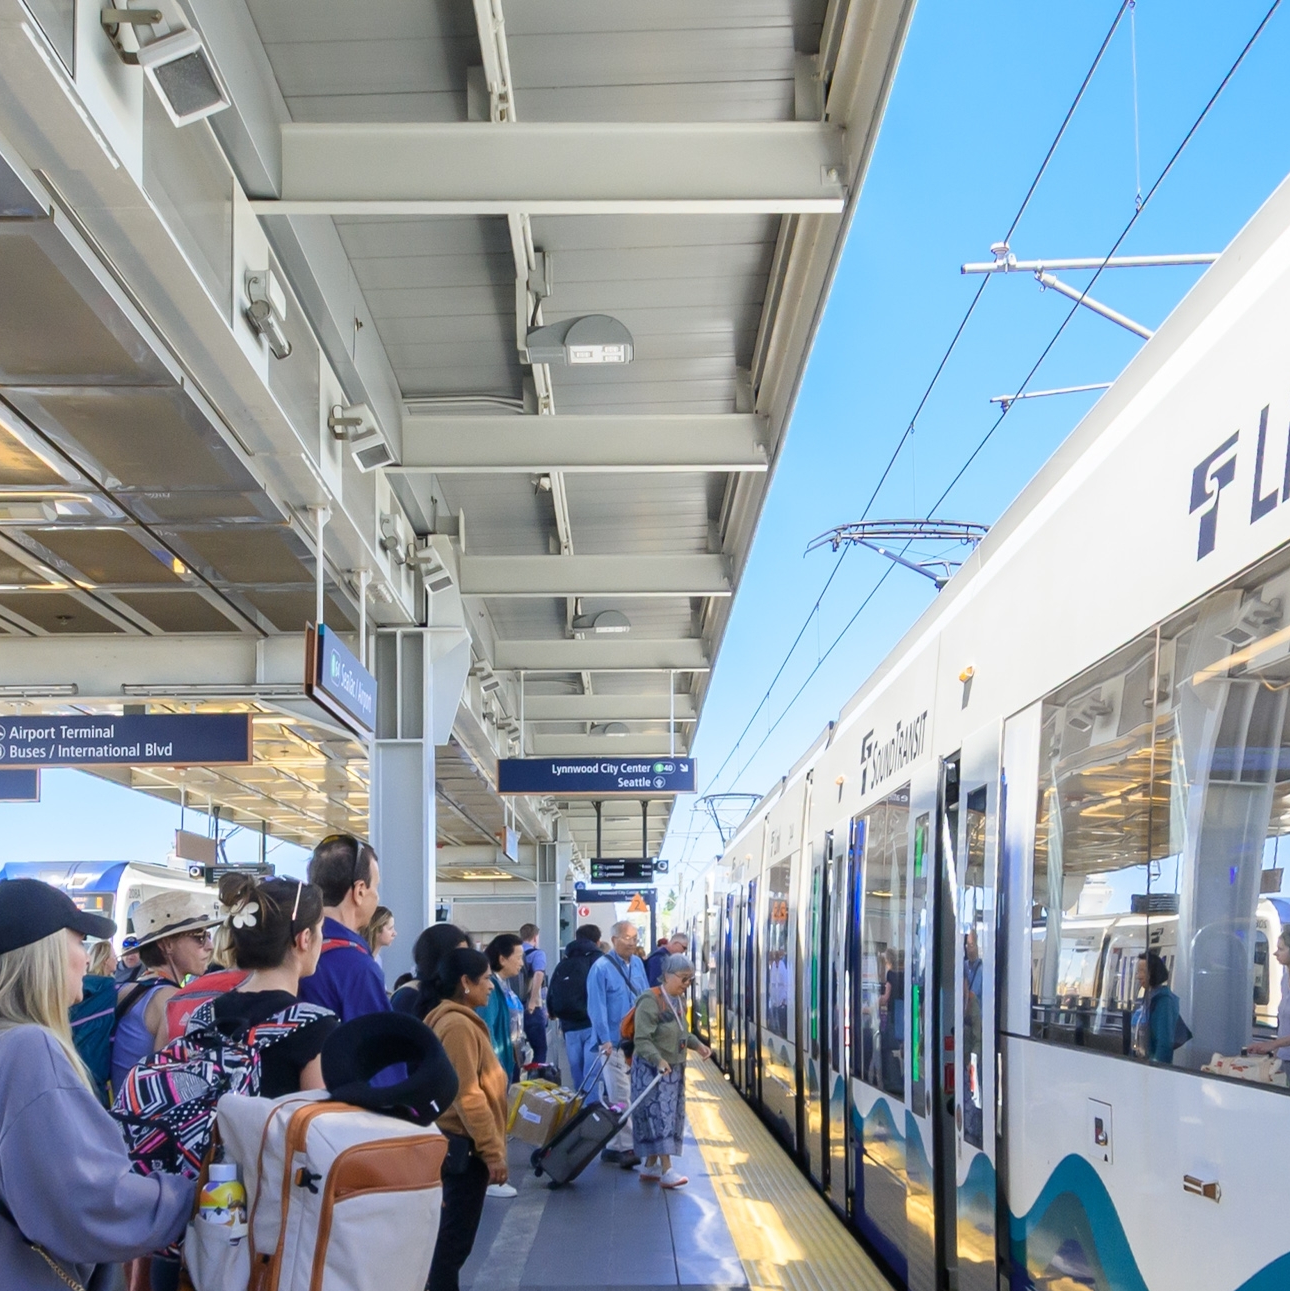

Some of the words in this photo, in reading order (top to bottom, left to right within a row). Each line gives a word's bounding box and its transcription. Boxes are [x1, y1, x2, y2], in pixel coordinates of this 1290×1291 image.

[341, 663, 356, 699] SeaTac
[357, 680, 372, 714] Airport
[9, 726, 56, 743] Airport
[60, 724, 115, 740] Terminal
[9, 745, 46, 758] Buses
[58, 743, 140, 757] International
[145, 742, 173, 756] Blvd
[552, 763, 599, 776] Lynnwood
[600, 763, 619, 776] City
[620, 763, 651, 773] Center
[618, 777, 651, 788] Seattle
[634, 900, 640, 911] 2
